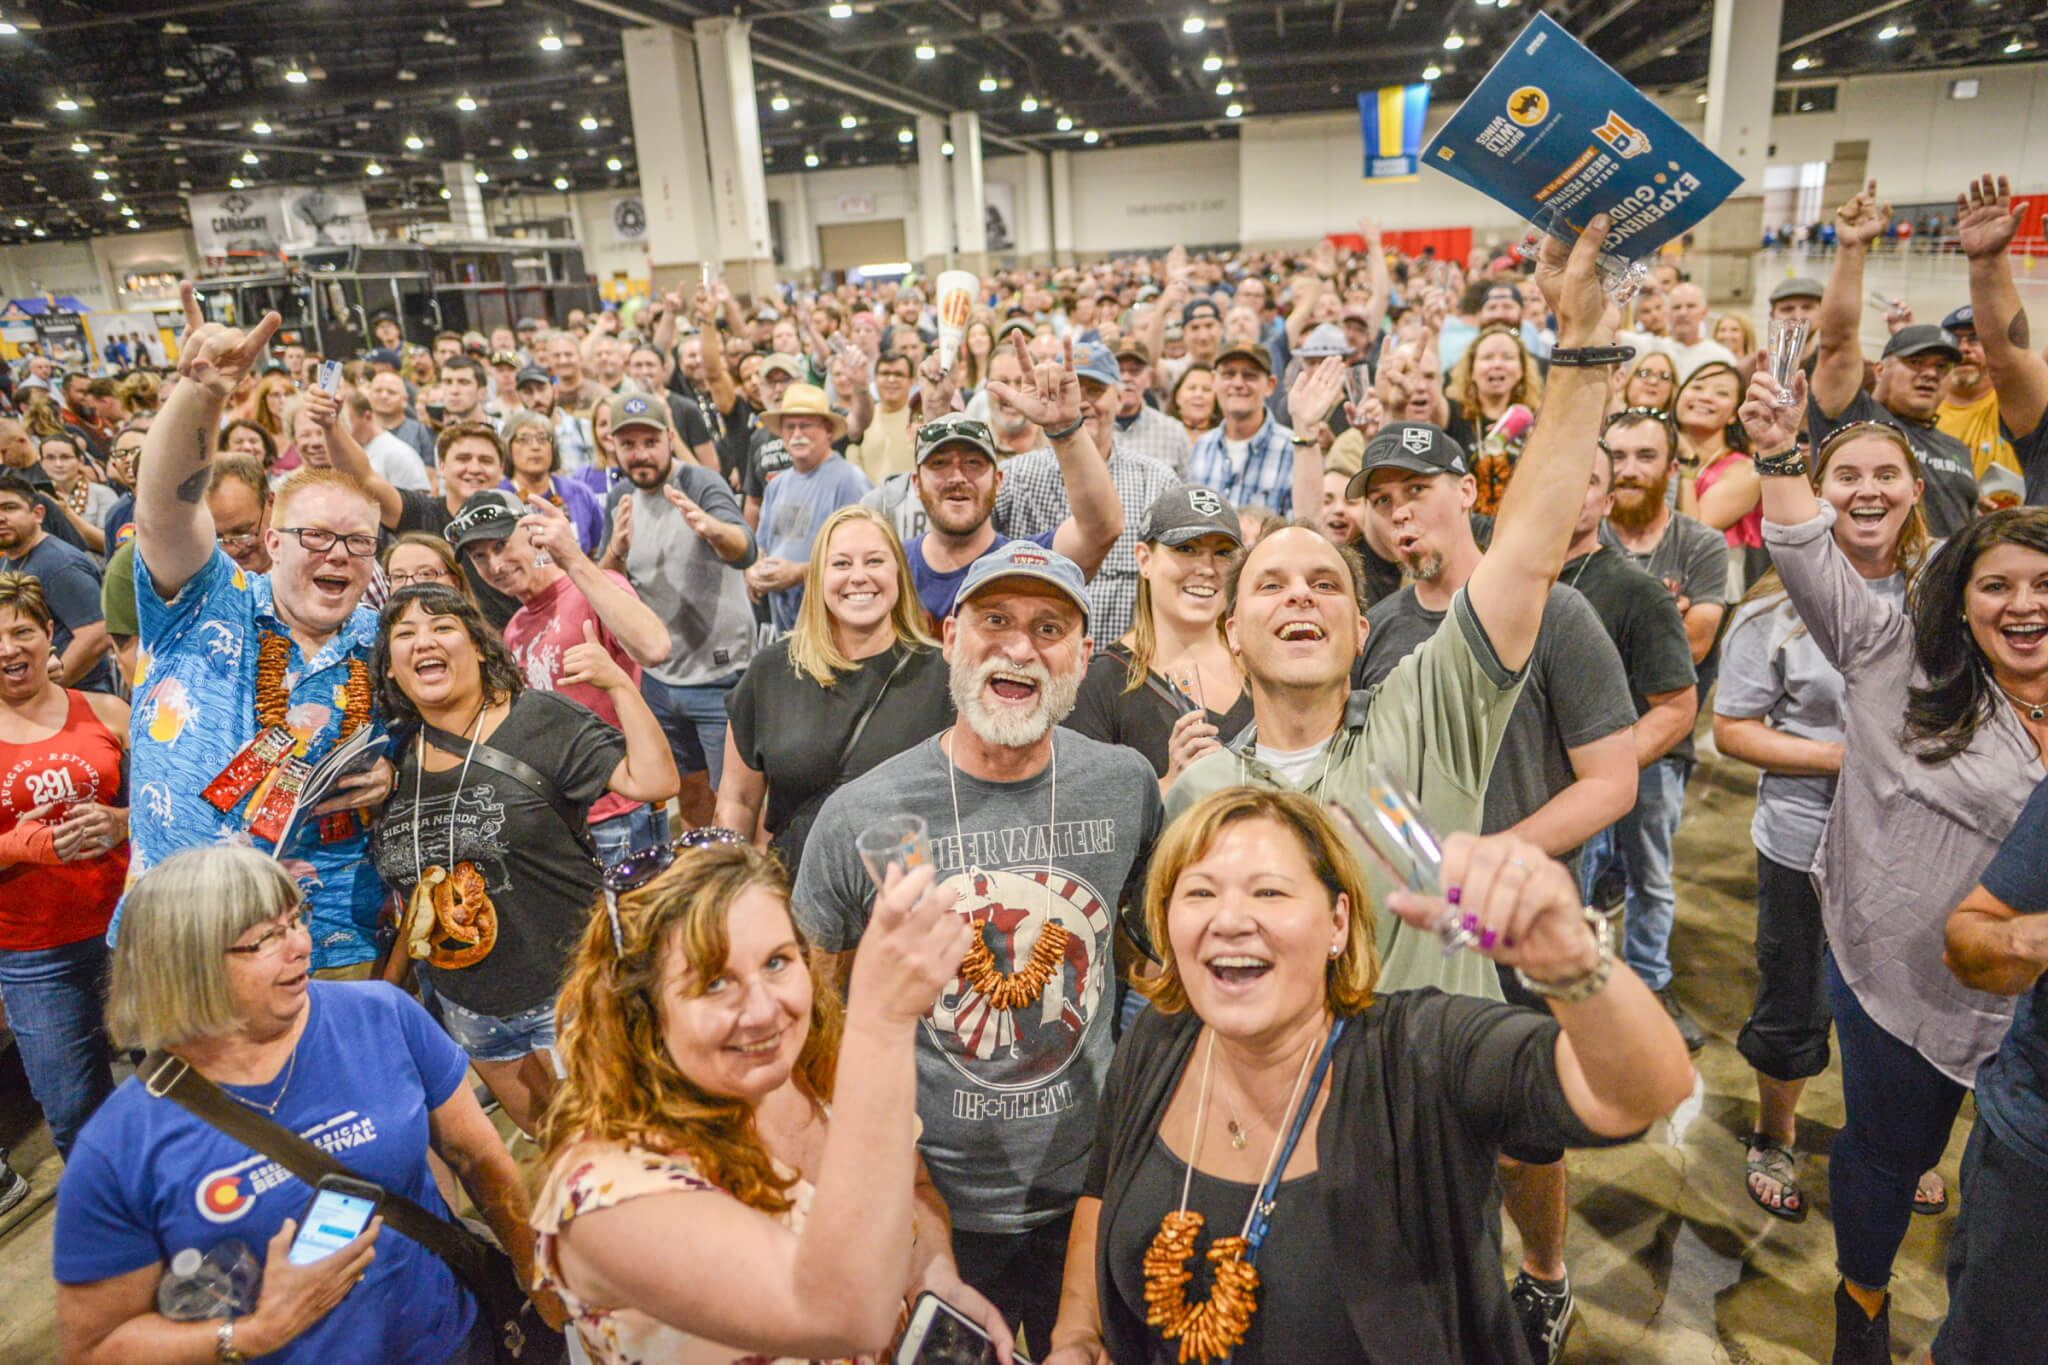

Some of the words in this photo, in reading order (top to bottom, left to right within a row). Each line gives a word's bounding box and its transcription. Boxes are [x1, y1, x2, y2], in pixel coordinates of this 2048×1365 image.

[1474, 115, 1505, 145] WINGS
[1484, 122, 1518, 153] WILD
[1496, 129, 1525, 158] BUFFALO
[1579, 153, 1611, 183] BEER
[1590, 161, 1620, 189] GREAT
[1543, 178, 1584, 208] FESTIVAL
[1, 759, 33, 808] RUGGED
[48, 752, 100, 786] REFINED
[25, 765, 77, 806] 291
[382, 818, 430, 840] SIERA
[433, 813, 477, 826] NEADA
[931, 831, 1000, 873] GER
[1000, 818, 1115, 864] WATERS
[320, 1127, 377, 1154] TIVAL
[249, 1162, 284, 1181] GRE
